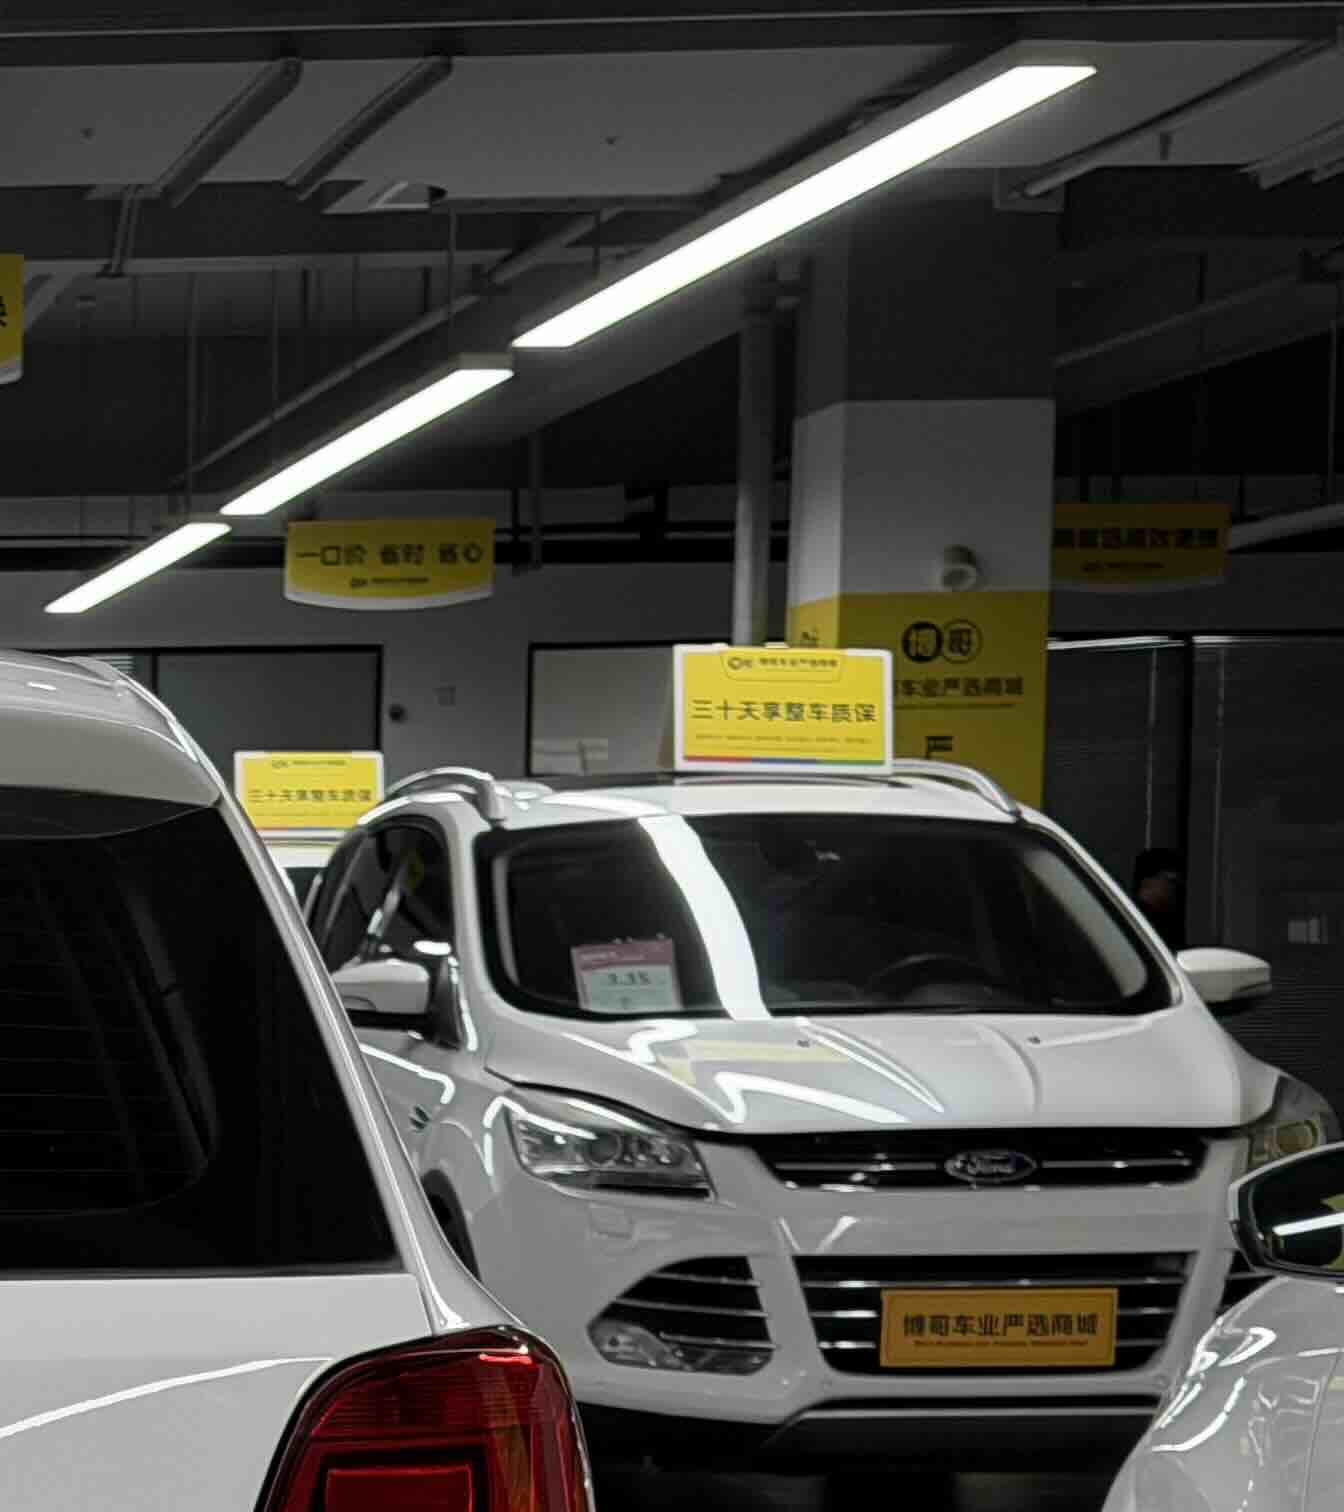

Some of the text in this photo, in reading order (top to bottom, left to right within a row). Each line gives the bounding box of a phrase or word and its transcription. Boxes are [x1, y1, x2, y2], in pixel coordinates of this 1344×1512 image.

[690, 699, 877, 723] 三十天享整车质保
